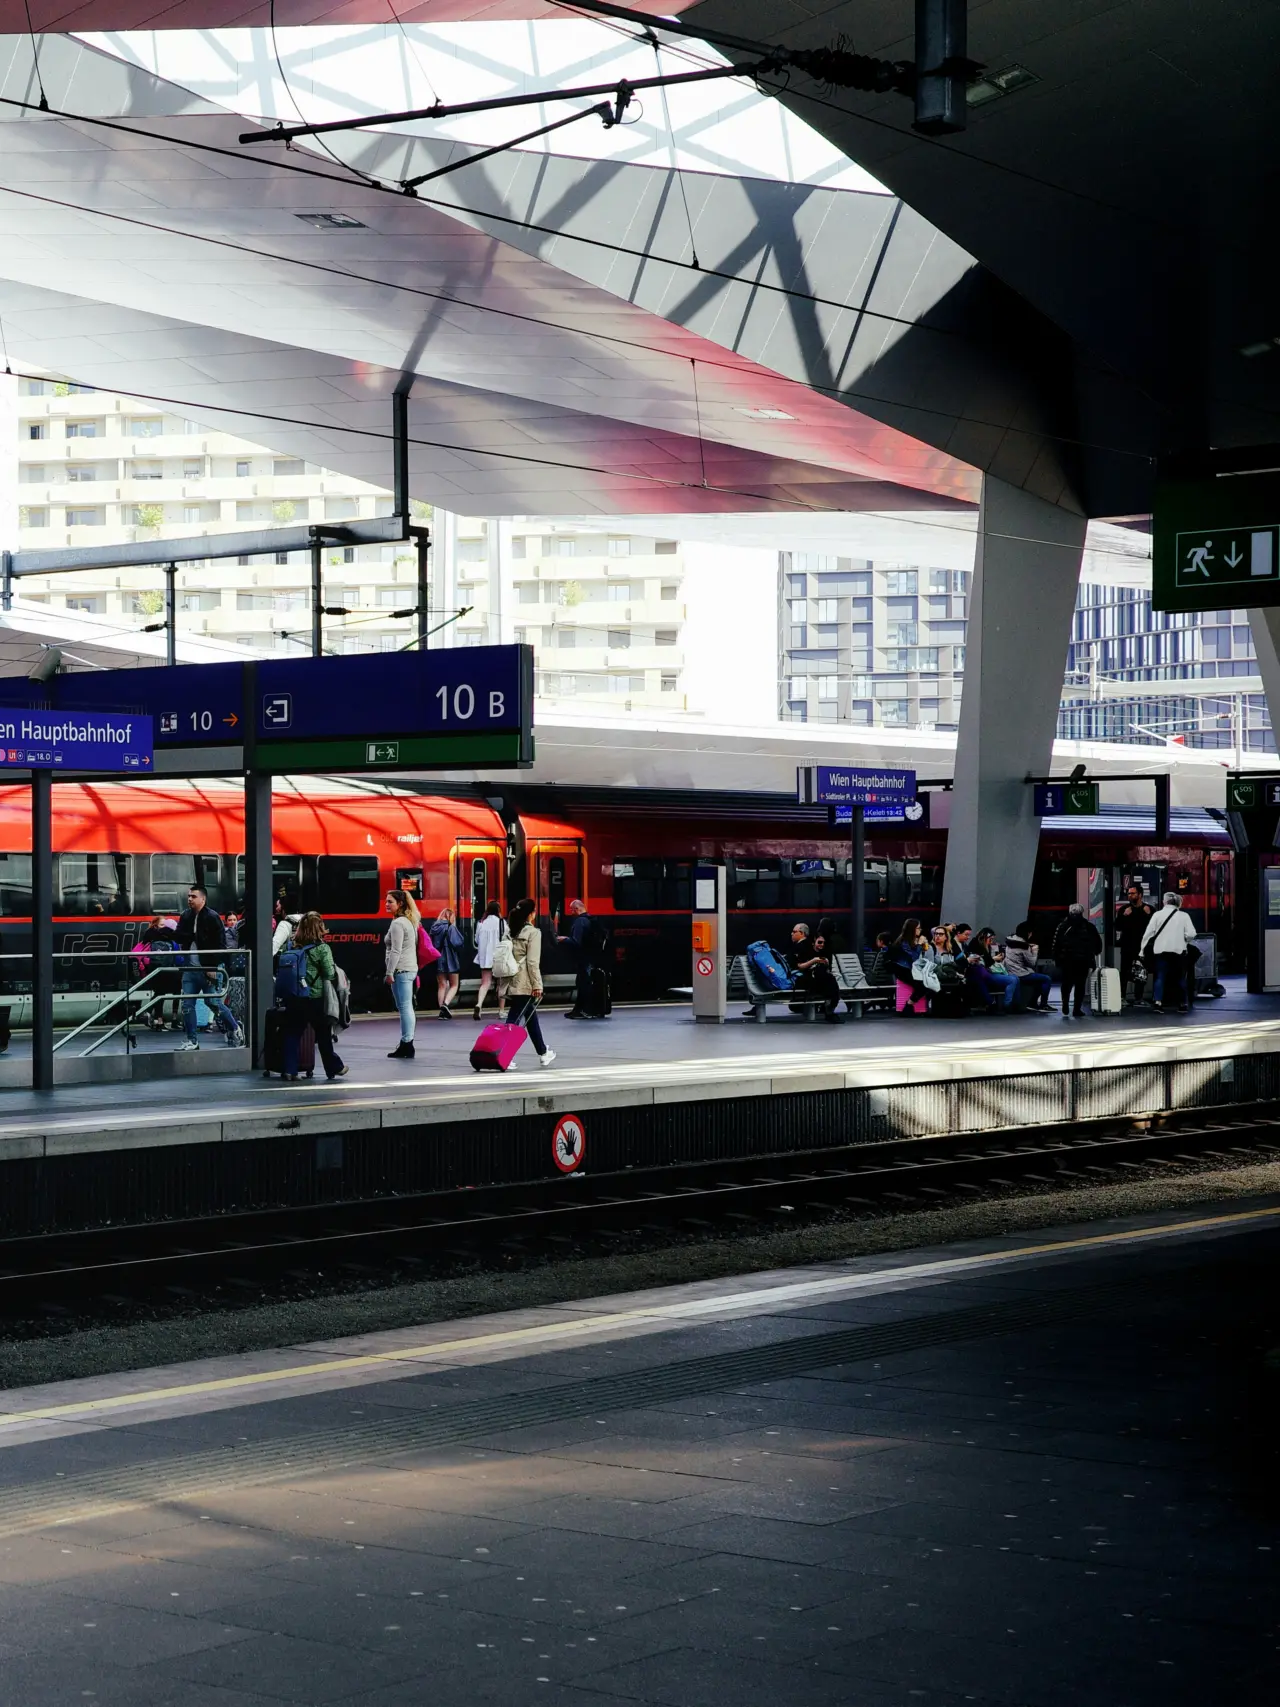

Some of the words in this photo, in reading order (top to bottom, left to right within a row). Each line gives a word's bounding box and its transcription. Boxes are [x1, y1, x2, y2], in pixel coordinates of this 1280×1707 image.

[435, 684, 475, 720] 10
[489, 691, 505, 718] B
[190, 711, 212, 731] 10
[21, 720, 132, 746] Hauptbahnhof
[829, 773, 850, 787] Wien
[852, 774, 906, 790] Hauptbahnhof
[1239, 785, 1253, 793] SOS
[1076, 789, 1089, 797] SOS
[397, 833, 424, 844] railjet
[474, 871, 485, 886] 2
[551, 870, 562, 885] 2
[323, 933, 381, 944] economy
